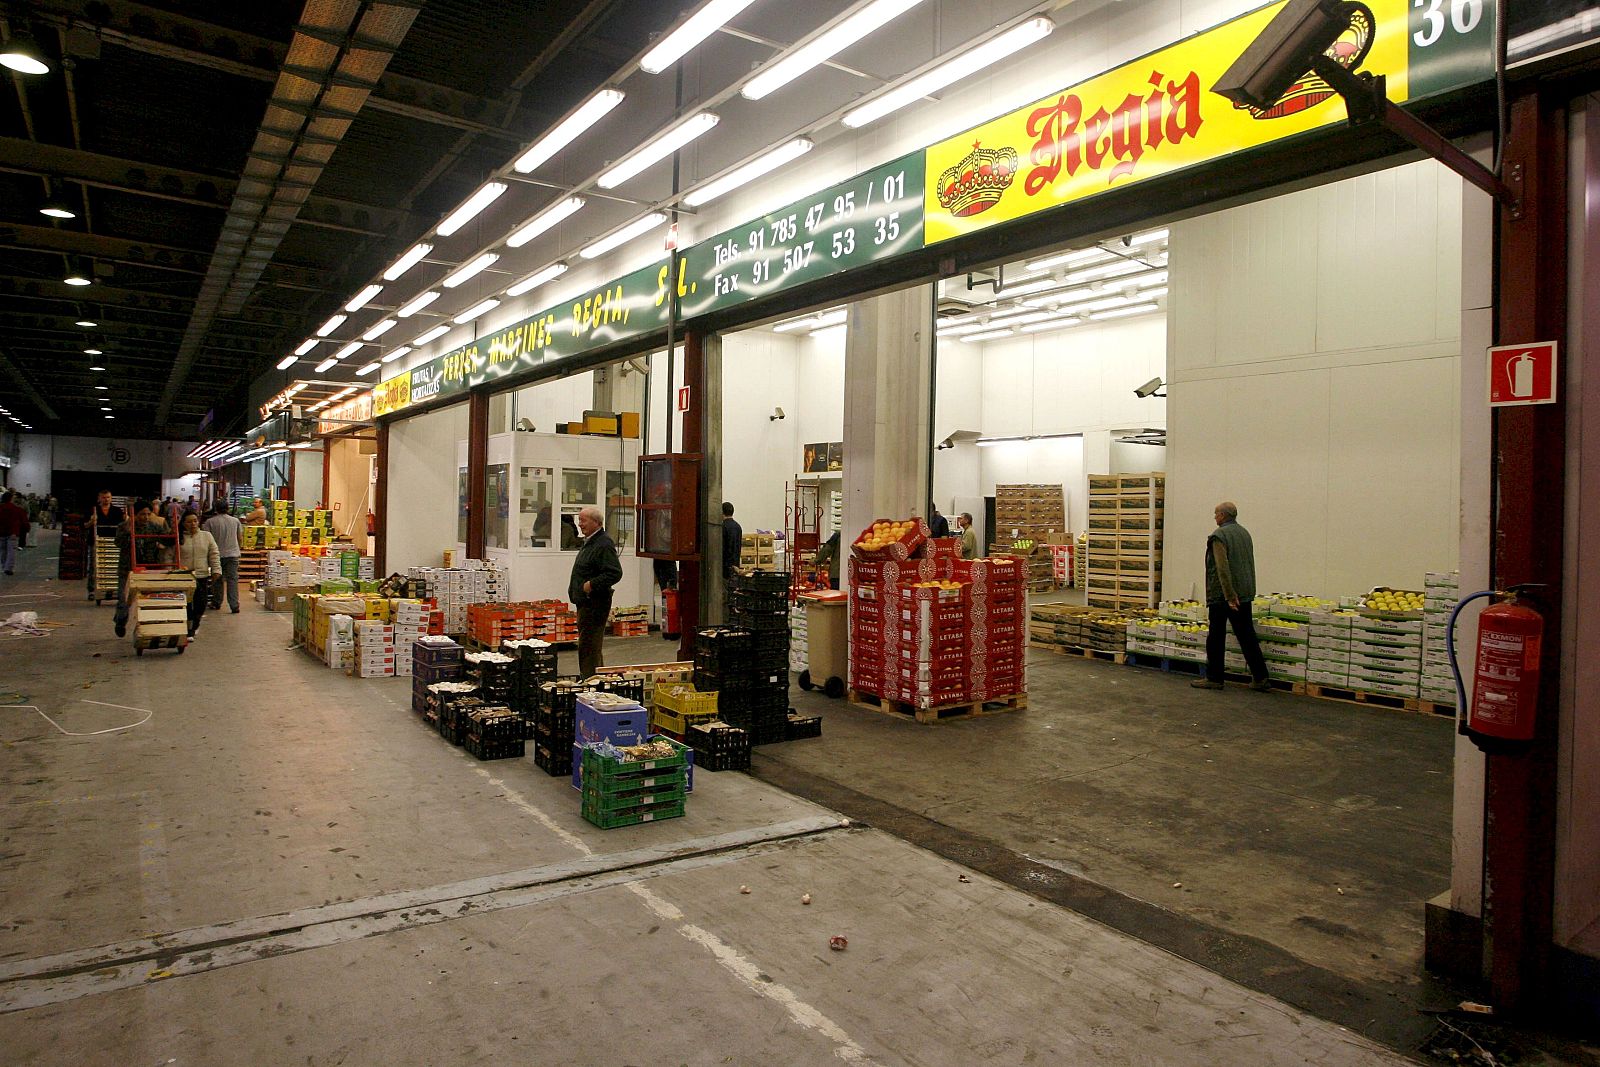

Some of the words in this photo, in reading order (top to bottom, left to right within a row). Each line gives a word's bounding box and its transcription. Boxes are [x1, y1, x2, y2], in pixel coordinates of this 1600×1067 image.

[1024, 70, 1203, 196] Regia
[714, 239, 741, 267] Tels.
[749, 227, 764, 254] 91
[771, 214, 797, 246] 785
[804, 203, 825, 232] 47
[834, 191, 855, 222] 95
[865, 182, 873, 211] /
[883, 171, 905, 204] 01
[714, 273, 739, 296] Fax
[752, 260, 770, 284] 91
[783, 241, 814, 274] 507
[832, 228, 855, 259] 53
[874, 213, 899, 245] 35
[572, 285, 630, 338] REGIA,
[430, 365, 434, 378] Y
[860, 606, 878, 614] LETABA
[939, 612, 963, 620] LETABA
[939, 632, 963, 640] LETABA
[993, 626, 1014, 634] LETABA
